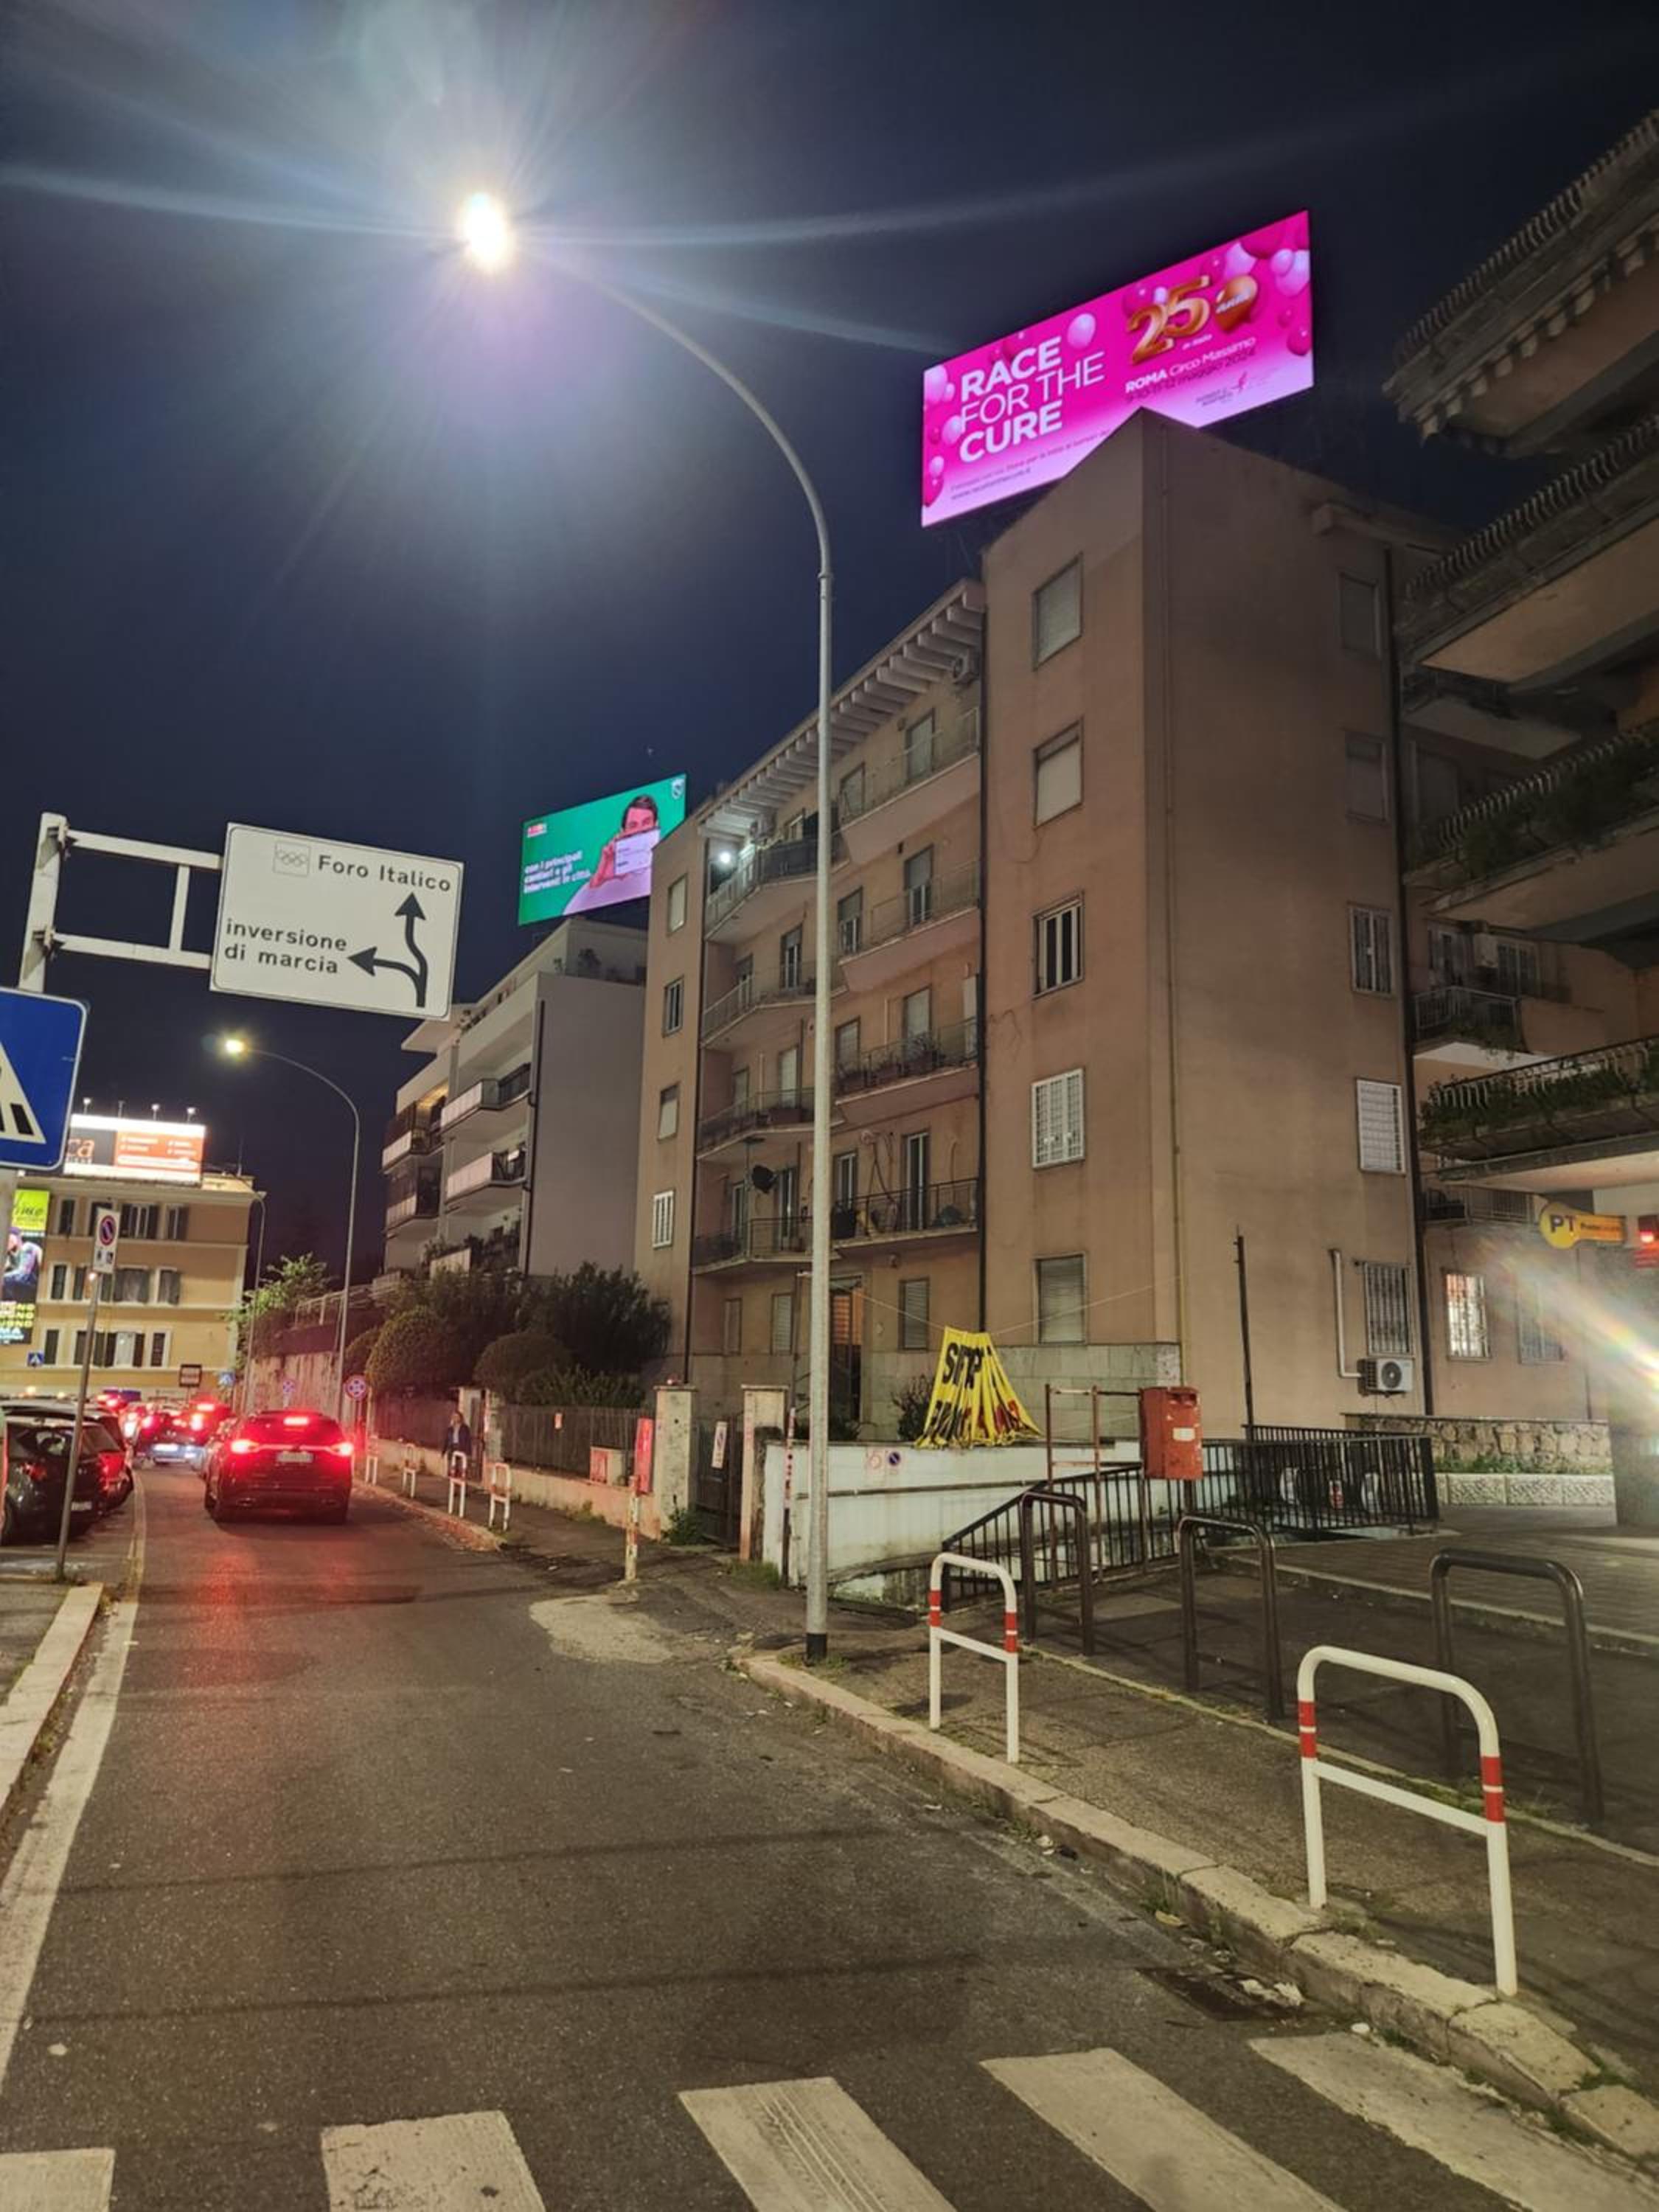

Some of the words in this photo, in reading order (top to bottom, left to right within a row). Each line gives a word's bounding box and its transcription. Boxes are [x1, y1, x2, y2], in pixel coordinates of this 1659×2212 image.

[1129, 276, 1211, 366] 25
[961, 336, 1062, 402] RACE
[961, 383, 1029, 434] FOR
[1034, 351, 1105, 402] THE
[1125, 369, 1167, 393] ROMA
[1169, 359, 1201, 377] Circo
[1202, 337, 1256, 364] Massimo
[959, 400, 1062, 462] CURE
[318, 854, 369, 878] Foro
[379, 865, 451, 891] Italico
[224, 944, 246, 961] di
[257, 950, 338, 974] marcia
[226, 918, 347, 951] inversione
